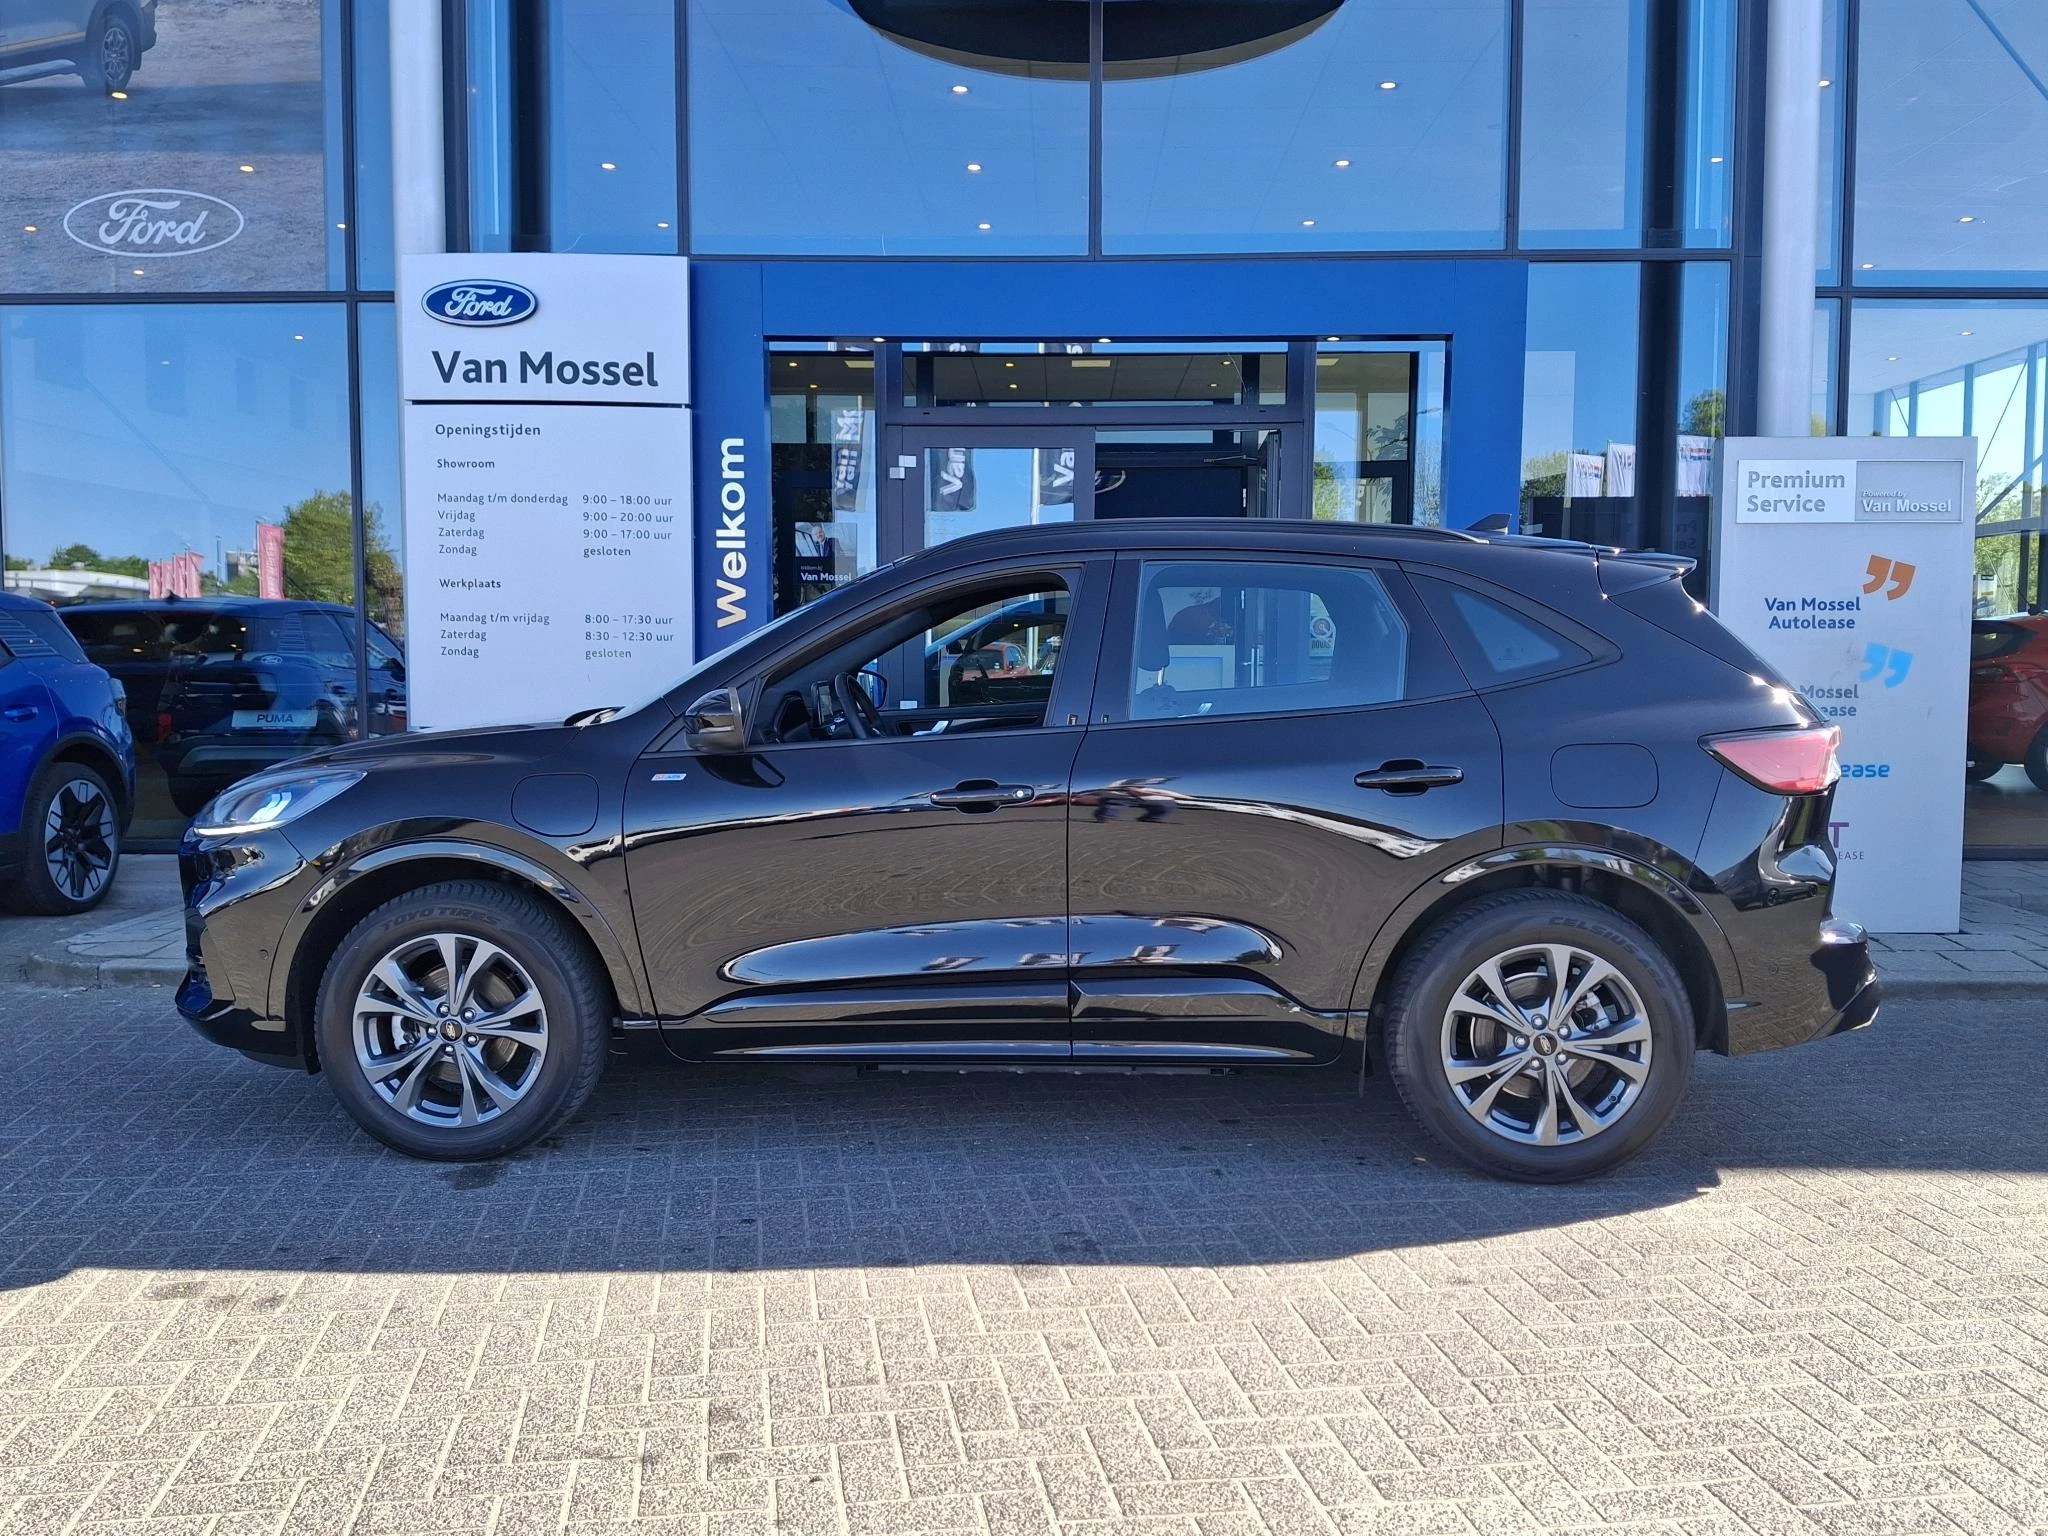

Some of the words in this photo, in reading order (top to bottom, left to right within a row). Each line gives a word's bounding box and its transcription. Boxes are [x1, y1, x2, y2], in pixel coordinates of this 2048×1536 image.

[99, 199, 209, 245] Ford
[444, 287, 513, 317] Ford
[431, 351, 507, 384] Van
[519, 351, 659, 387] Mossel
[435, 423, 541, 439] Openingstijden
[436, 458, 496, 469] Showroom
[1747, 470, 1846, 489] Premium
[437, 492, 485, 506] Maandag
[487, 492, 508, 503] t/m
[510, 492, 569, 507] donderdag
[582, 494, 608, 505] 9:00
[619, 495, 651, 505] 18:00
[654, 498, 673, 506] uur
[1746, 494, 1826, 513] Service
[1862, 499, 1891, 512] Van
[1896, 499, 1952, 512] Mossel
[437, 509, 476, 523] Vrijdag
[582, 511, 608, 522] 9:00
[619, 512, 652, 523] 20:00
[655, 515, 674, 523] uur
[438, 526, 485, 540] Zaterdag
[583, 528, 608, 539] 9:00
[620, 529, 651, 540] 17:00
[653, 532, 673, 540] uur
[715, 437, 747, 629] Welkom
[438, 544, 478, 557] Zondag
[583, 545, 631, 559] gesloten
[800, 572, 818, 581] Van
[820, 571, 852, 581] Mossel
[438, 577, 502, 591] Werkplaats
[1764, 597, 1796, 612] Van
[1801, 596, 1861, 612] Mossel
[440, 611, 487, 625] Maandag
[490, 612, 510, 623] t/m
[512, 612, 550, 626] vrijdag
[584, 614, 610, 624] 8:00
[621, 614, 652, 625] 17:30
[655, 617, 673, 625] uur
[1768, 615, 1856, 630] Autolease
[440, 628, 487, 642] Zaterdag
[585, 631, 610, 641] 8:30
[622, 631, 653, 642] 12:30
[656, 634, 674, 642] uur
[440, 645, 480, 659] Zondag
[585, 647, 632, 661] gesloten
[256, 714, 294, 723] PUMA
[1820, 706, 1857, 717] ease
[1840, 764, 1890, 778] ease
[1838, 851, 1865, 860] EASE
